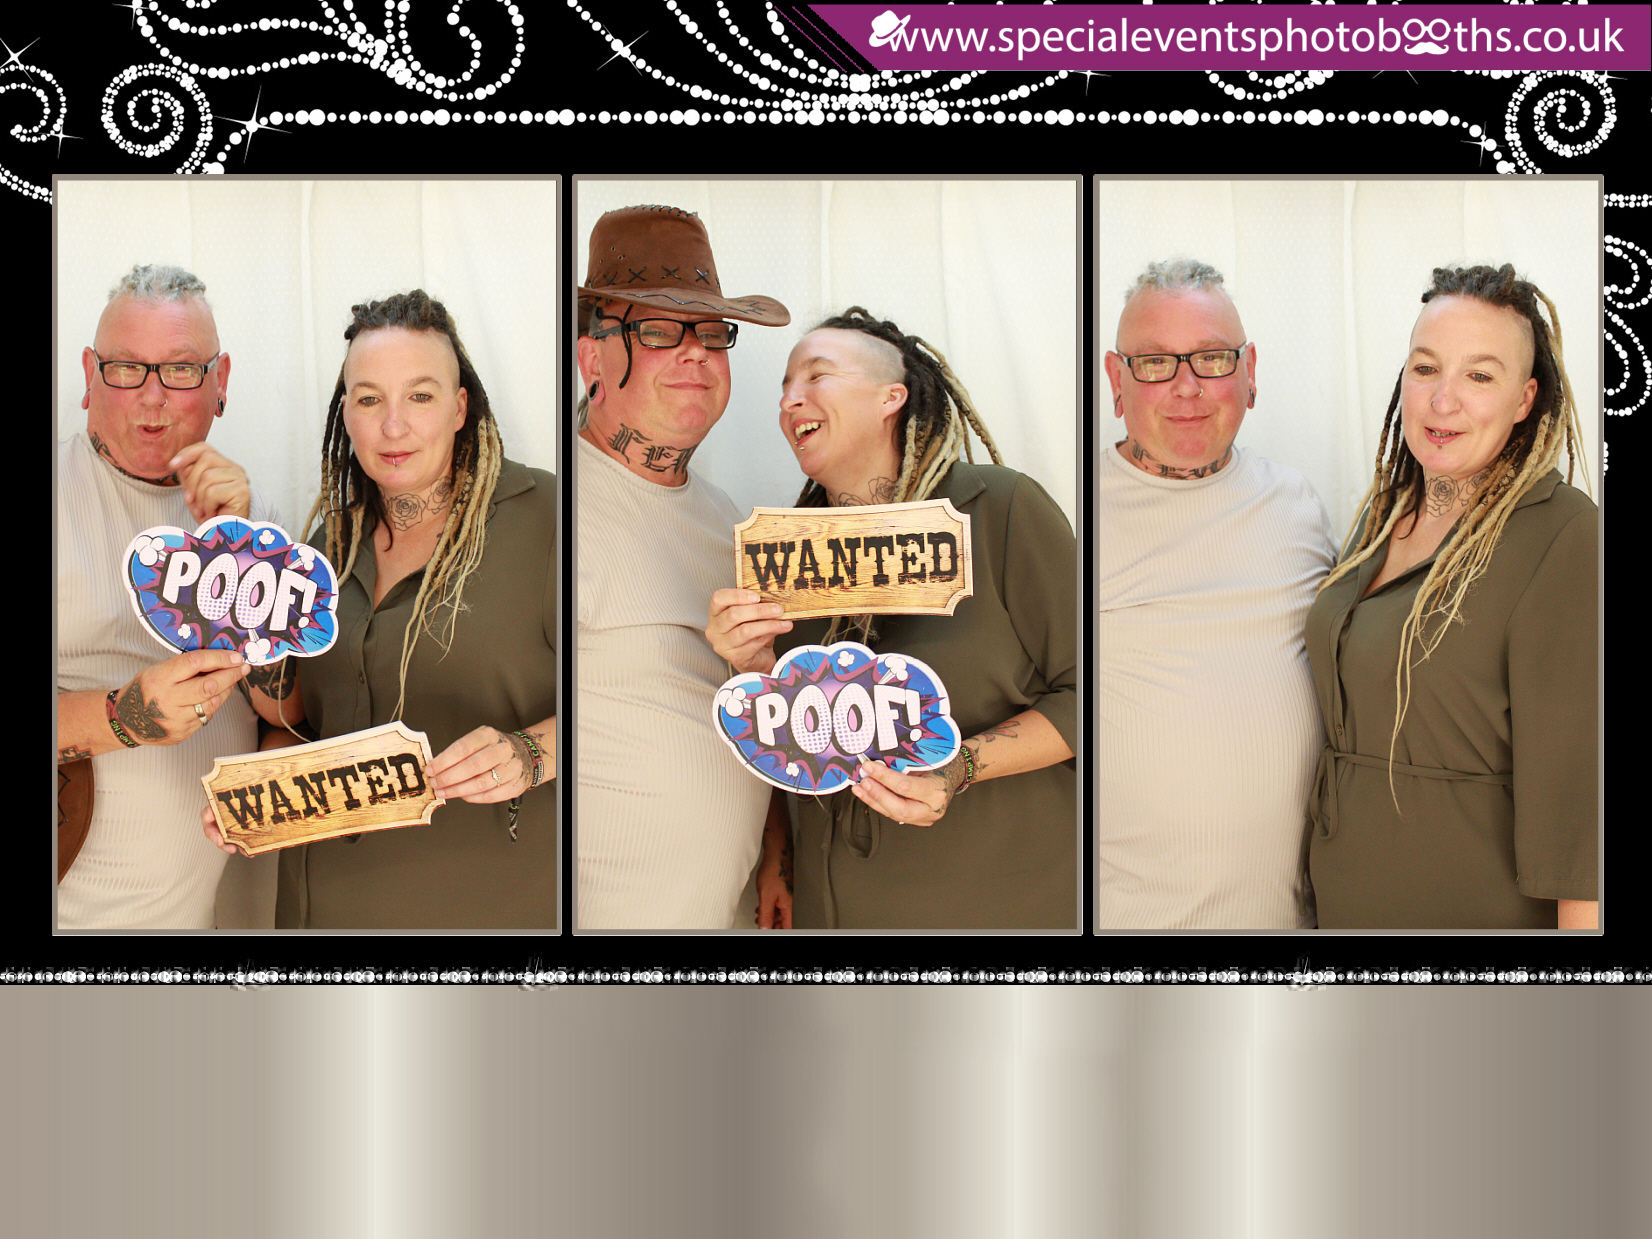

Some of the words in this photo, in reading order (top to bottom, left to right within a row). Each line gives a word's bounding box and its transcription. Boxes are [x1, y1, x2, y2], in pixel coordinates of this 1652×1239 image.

[162, 550, 319, 631] POOF!
[745, 531, 960, 591] WANTED
[755, 682, 923, 755] POOF!
[215, 752, 427, 830] WANTED
